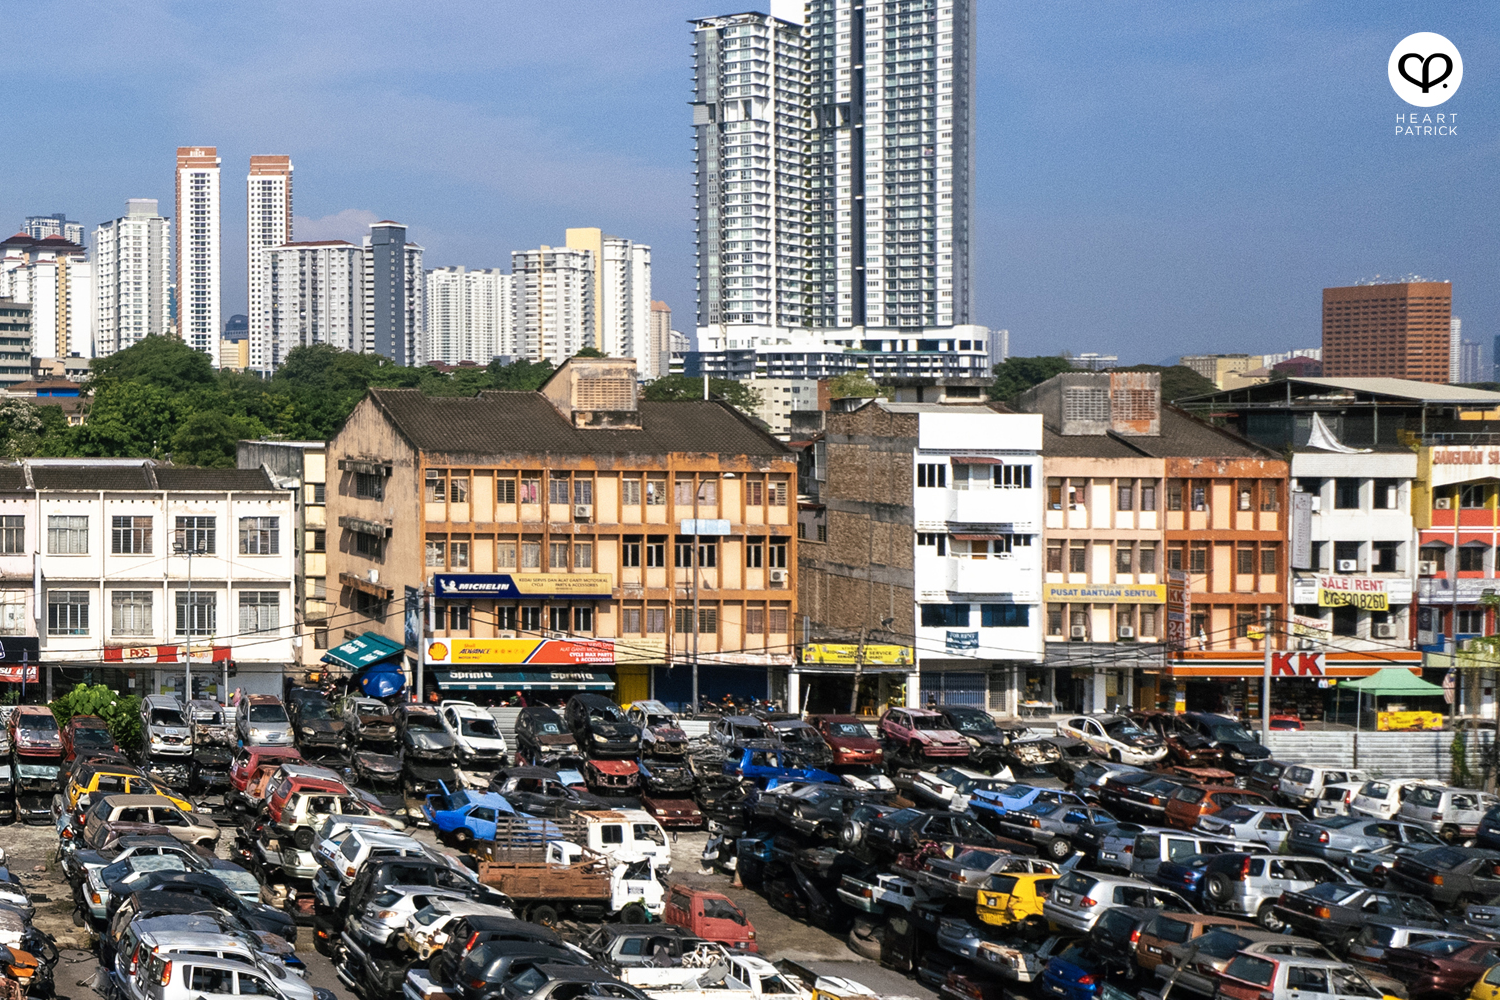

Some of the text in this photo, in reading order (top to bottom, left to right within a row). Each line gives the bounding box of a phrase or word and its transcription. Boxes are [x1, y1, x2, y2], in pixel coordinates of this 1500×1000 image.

[1321, 578, 1348, 590] SALE
[1355, 580, 1384, 591] RENT
[1081, 589, 1121, 597] BANTUAN
[1169, 621, 1184, 637] 24
[130, 648, 150, 658] POS
[1272, 652, 1323, 676] KK
